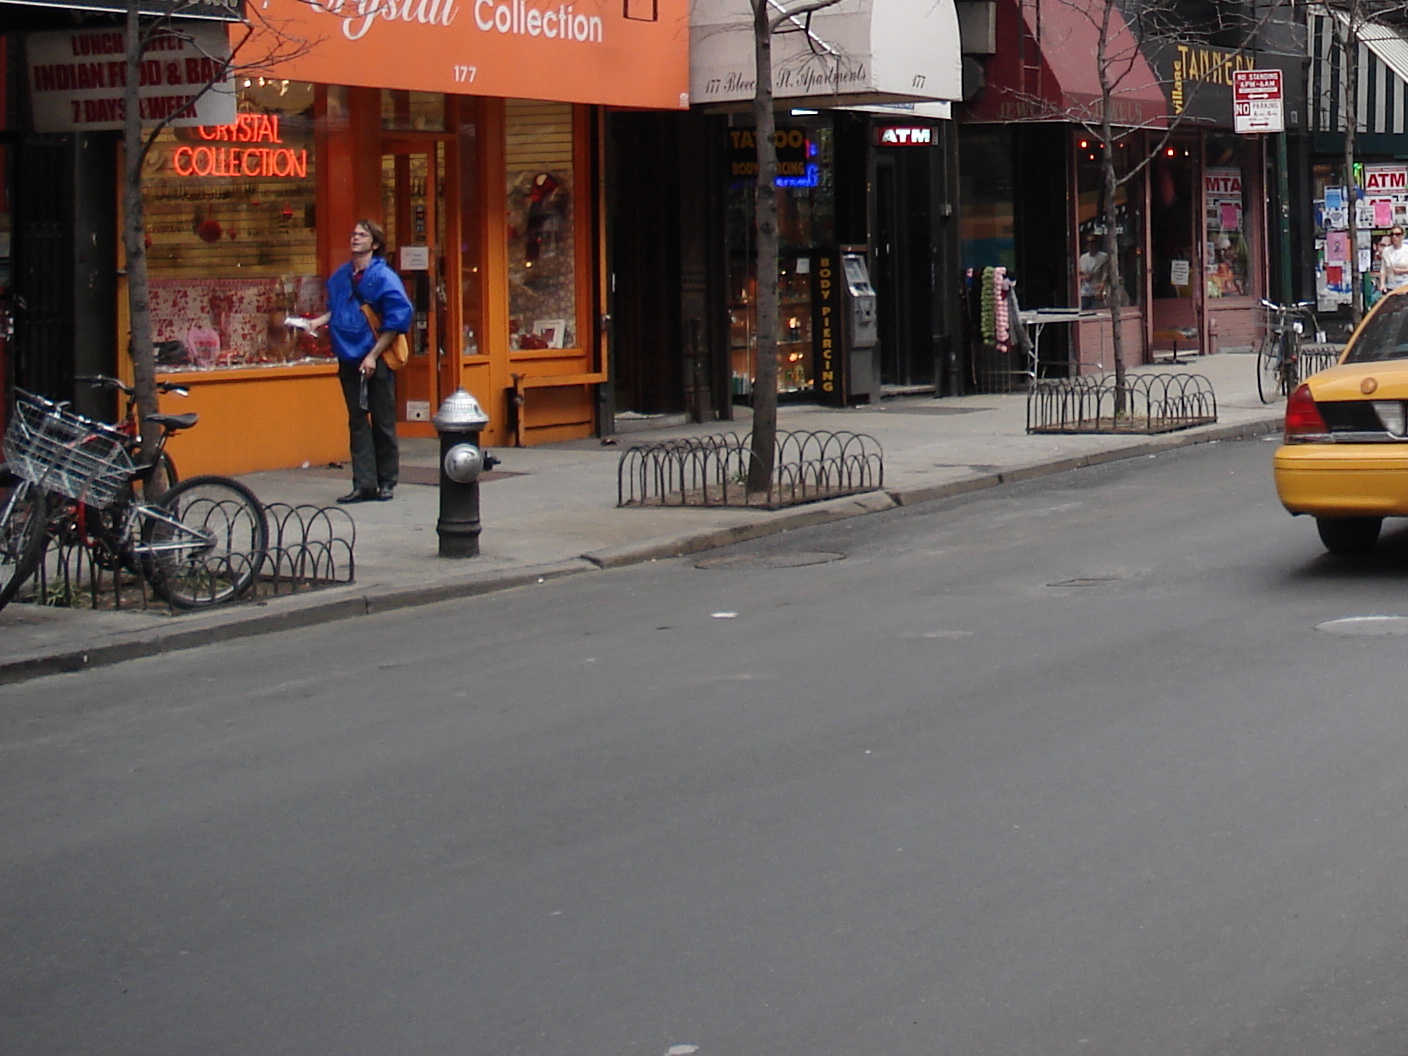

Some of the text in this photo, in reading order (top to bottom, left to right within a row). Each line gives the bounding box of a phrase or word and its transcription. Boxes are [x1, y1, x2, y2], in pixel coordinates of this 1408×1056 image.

[34, 63, 104, 92] INDIAN
[455, 65, 477, 83] 177
[797, 63, 867, 93] Apartments
[71, 100, 80, 123] 7
[145, 95, 198, 120] WEEK
[1236, 102, 1250, 115] NO
[730, 131, 803, 149] TAOO
[881, 129, 931, 143] ATM
[174, 147, 306, 177] COLLECTION
[1368, 173, 1405, 187] ATM
[819, 258, 832, 300] BODY
[821, 306, 834, 392] PIERCING
